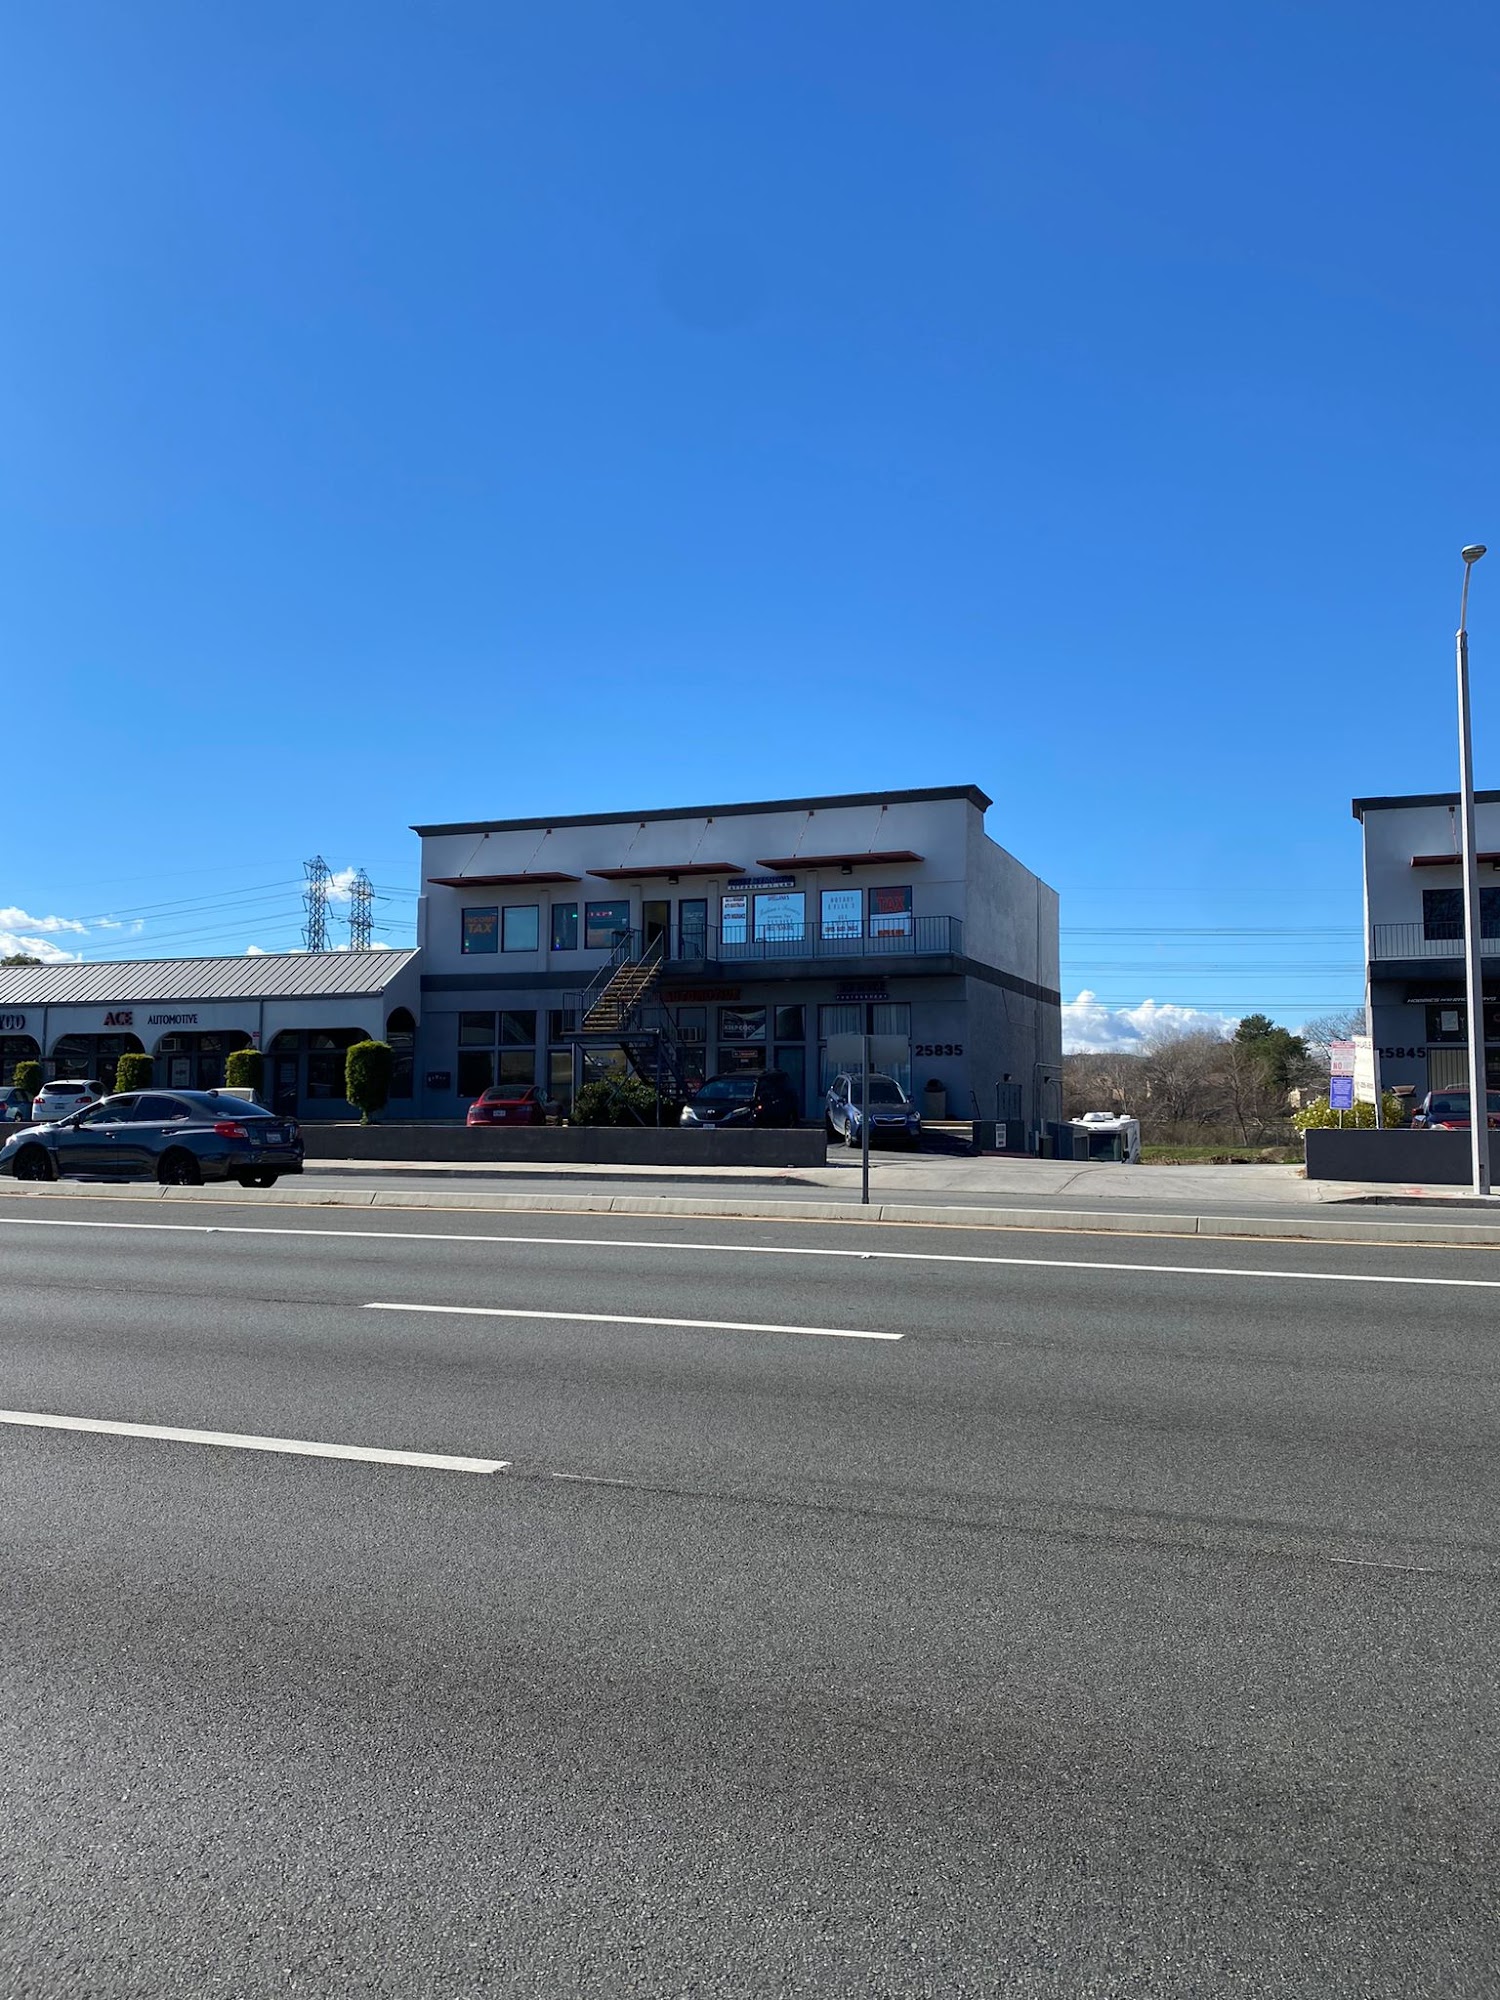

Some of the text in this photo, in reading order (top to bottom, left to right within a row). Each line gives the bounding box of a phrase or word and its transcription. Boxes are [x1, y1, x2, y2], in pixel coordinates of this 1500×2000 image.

[877, 895, 905, 912] TAX
[468, 923, 492, 934] TAX
[103, 1011, 198, 1026] ACE AUTOMOTIVE
[915, 1044, 963, 1057] 25835
[1378, 1047, 1426, 1059] 25845
[1333, 1061, 1343, 1070] NO
